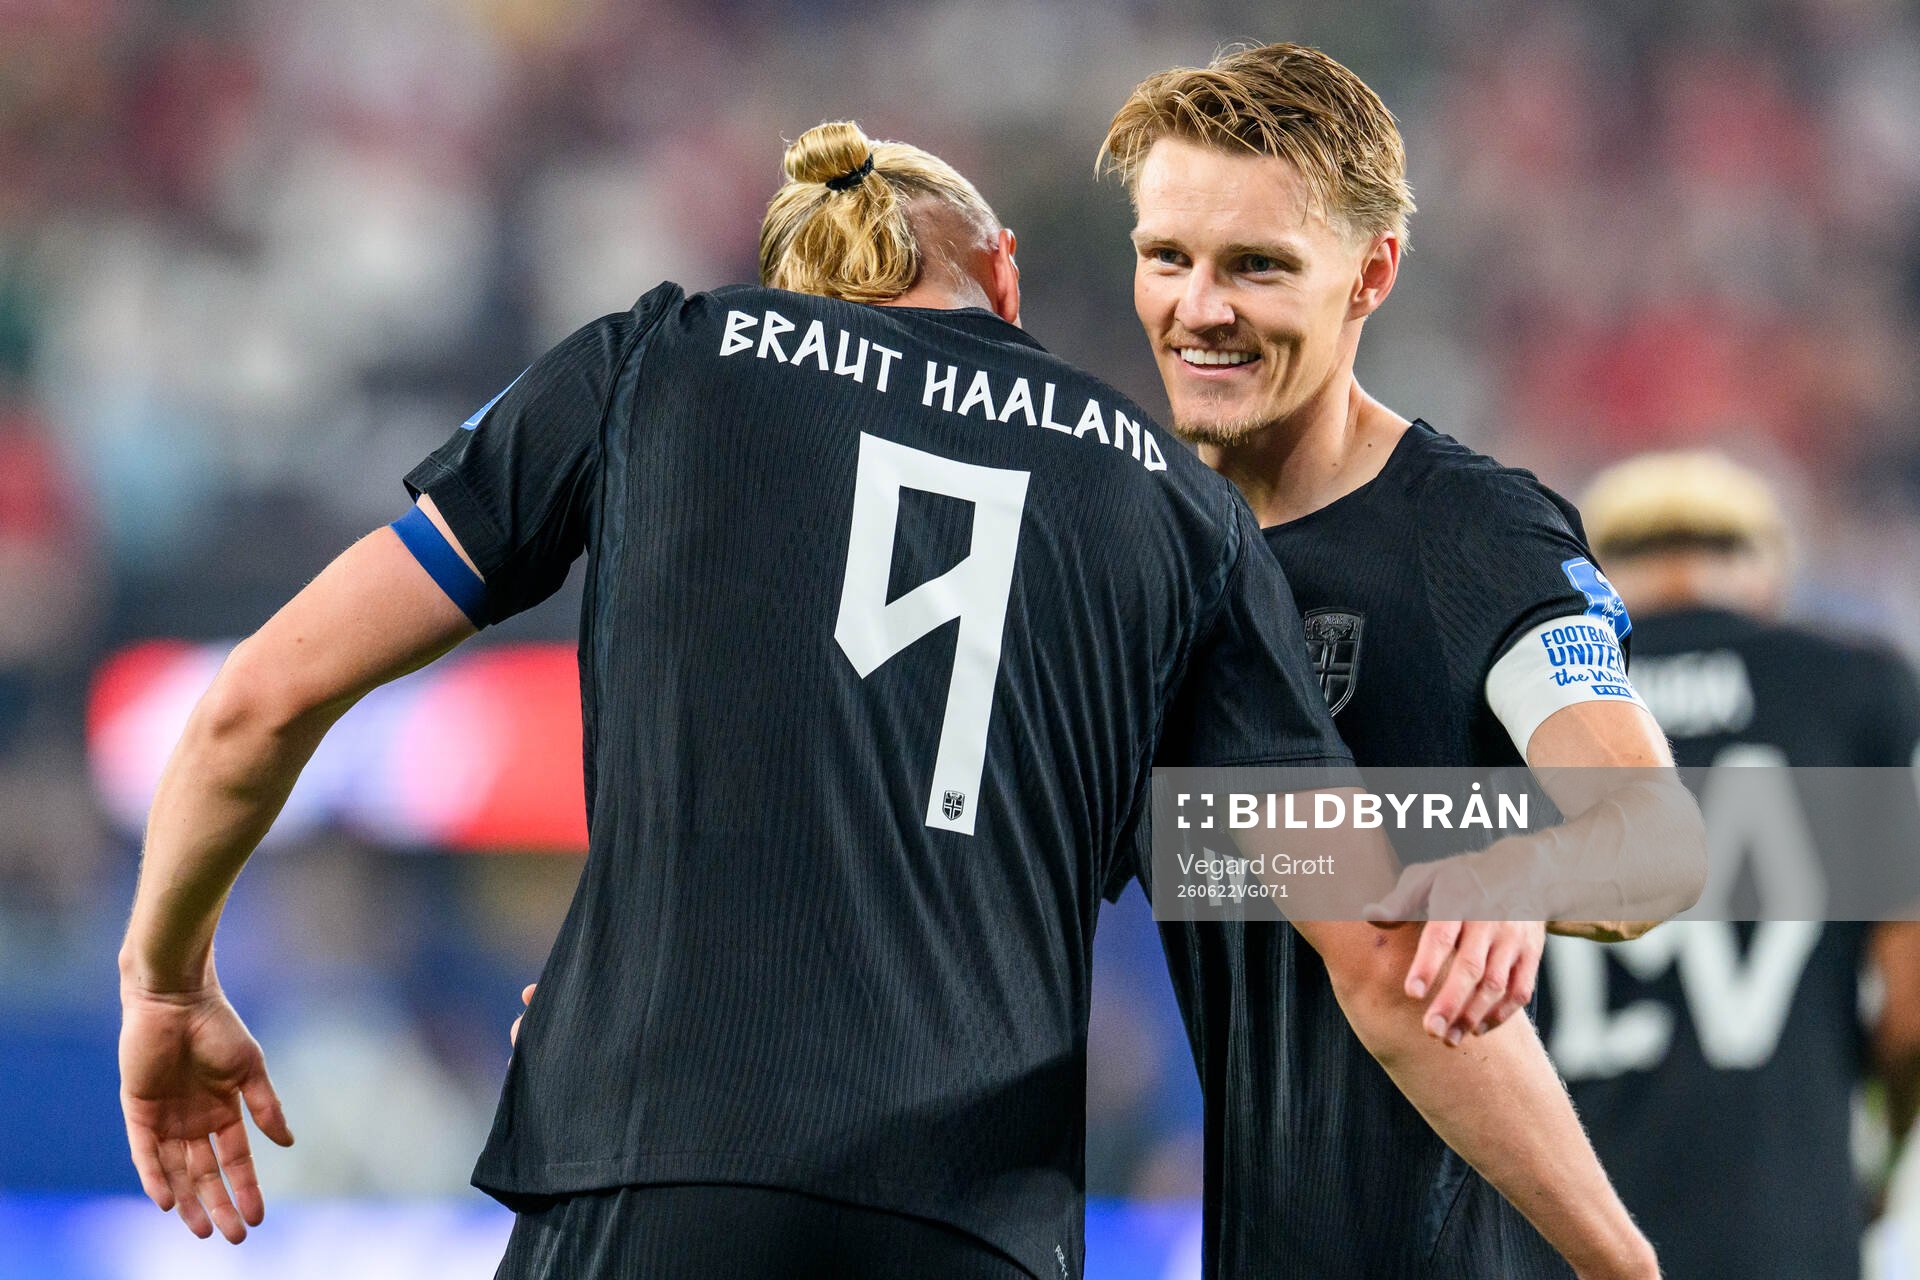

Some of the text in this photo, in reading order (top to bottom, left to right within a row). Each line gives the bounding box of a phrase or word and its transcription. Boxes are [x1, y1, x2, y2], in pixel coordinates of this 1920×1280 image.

[719, 310, 1167, 472] BRAUT HAALAND
[833, 430, 1031, 836] 9
[1549, 668, 1589, 687] the
